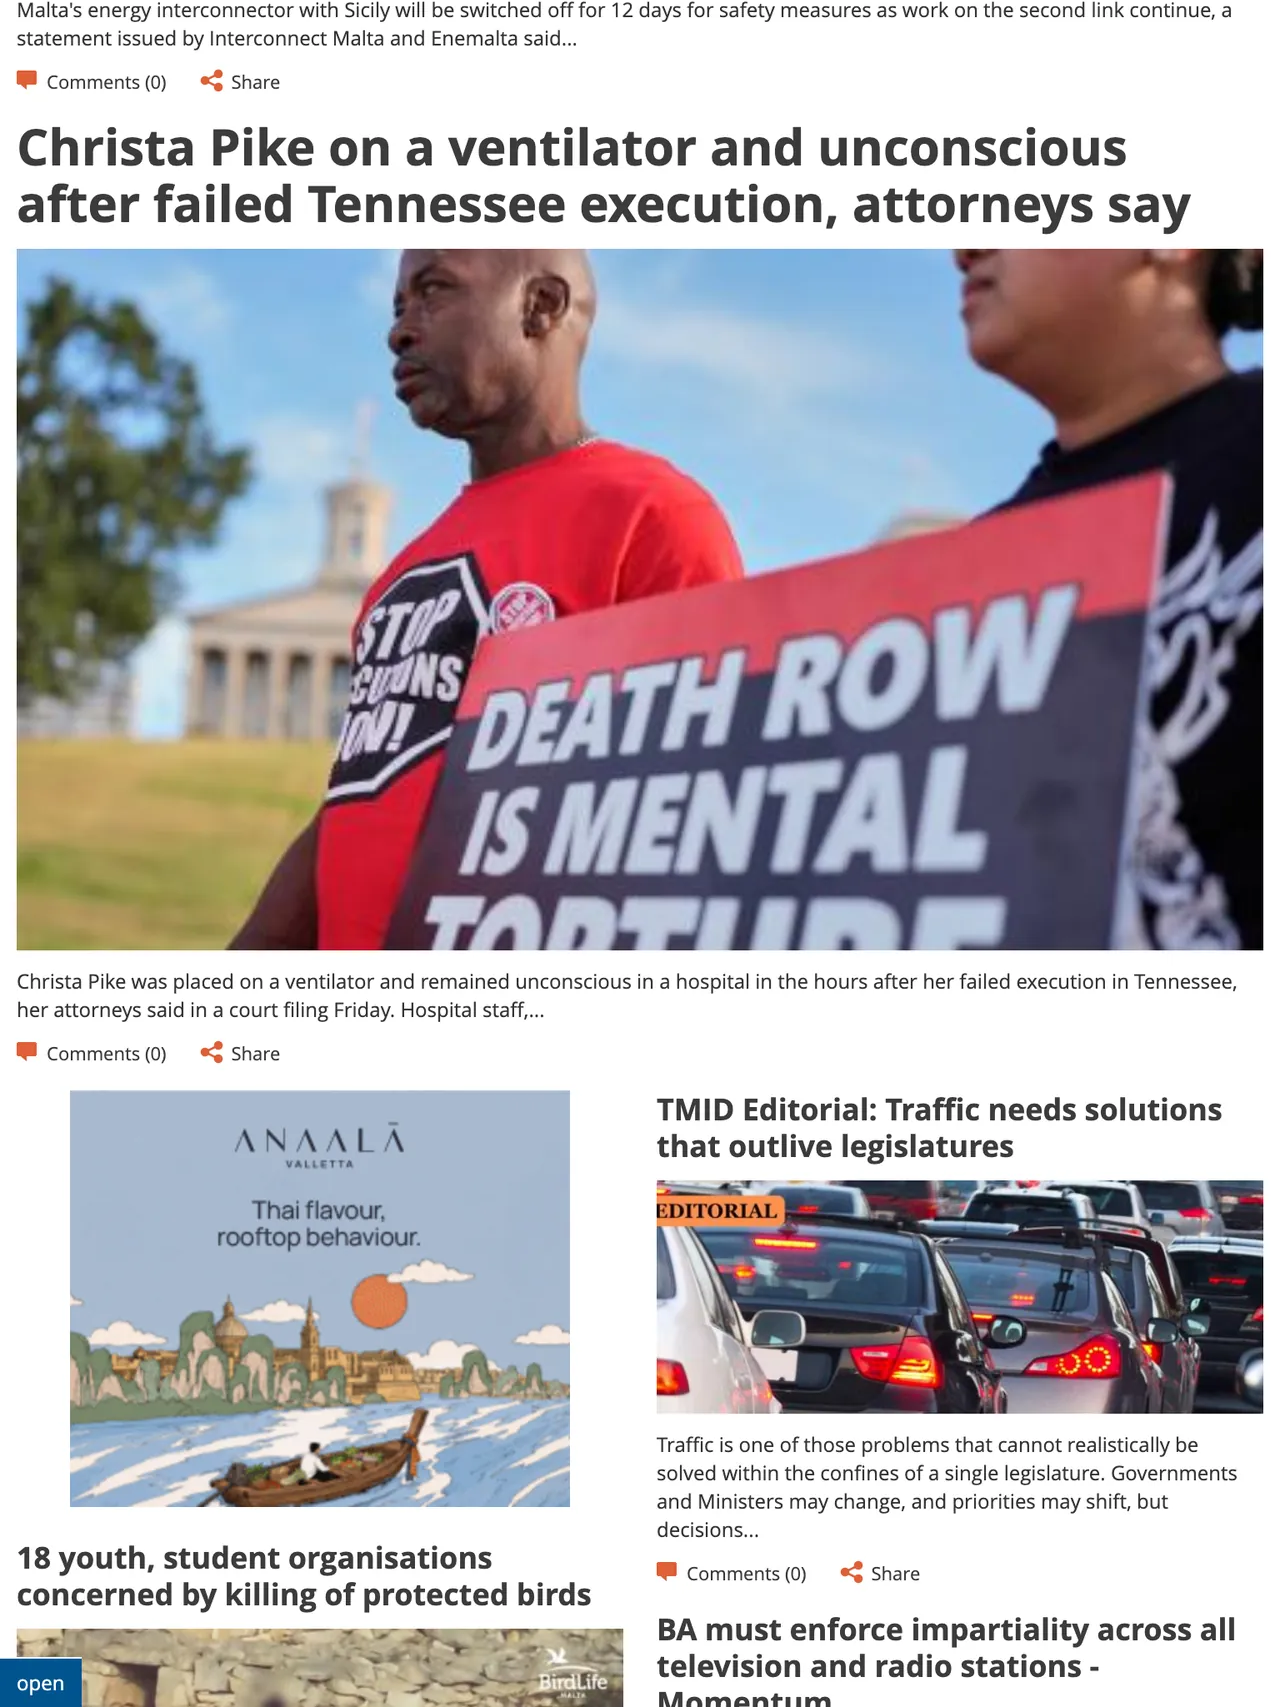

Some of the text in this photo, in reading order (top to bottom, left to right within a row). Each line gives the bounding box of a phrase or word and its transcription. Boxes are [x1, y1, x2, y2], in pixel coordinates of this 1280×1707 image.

[17, 30, 576, 51] statement issued by Interconnect Malta and Enemalta said...
[47, 75, 166, 92] Comments (0)
[232, 74, 280, 89] Share
[19, 127, 1126, 166] Christa Pike on a ventilator and unconscious
[18, 183, 1191, 234] after failed Tennessee execution, attorneys say
[357, 589, 461, 664] STOP
[465, 583, 1077, 771] DEATH ROW
[458, 745, 989, 876] IS MENTAL
[18, 1001, 544, 1022] her attorneys said in a court filing Friday. Hospital staff,...
[47, 1047, 166, 1064] Comments (0)
[232, 1046, 280, 1061] Share
[657, 1097, 1222, 1121] TMID Editorial: Traffic needs solutions
[657, 1134, 1013, 1165] that outlive legislatures
[286, 1160, 353, 1169] VALLETTA
[252, 1200, 385, 1222] Thai flavour,
[218, 1227, 420, 1252] rooftop behaviour.
[656, 1436, 1198, 1457] Traffic is one of those problems that cannot realistically be
[657, 1521, 758, 1538] decisions...
[18, 1545, 492, 1576] 18 youth, student organisations
[687, 1567, 806, 1584] Comments (0)
[872, 1566, 920, 1581] Share
[18, 1582, 591, 1613] concerned by killing of protected birds
[659, 1617, 1234, 1648] BA must enforce impartiality across all
[657, 1653, 800, 1678] television
[811, 1653, 865, 1678] and
[876, 1653, 952, 1678] radio
[961, 1654, 1081, 1678] stations
[17, 1679, 64, 1696] open
[659, 1692, 831, 1707] Momentum
